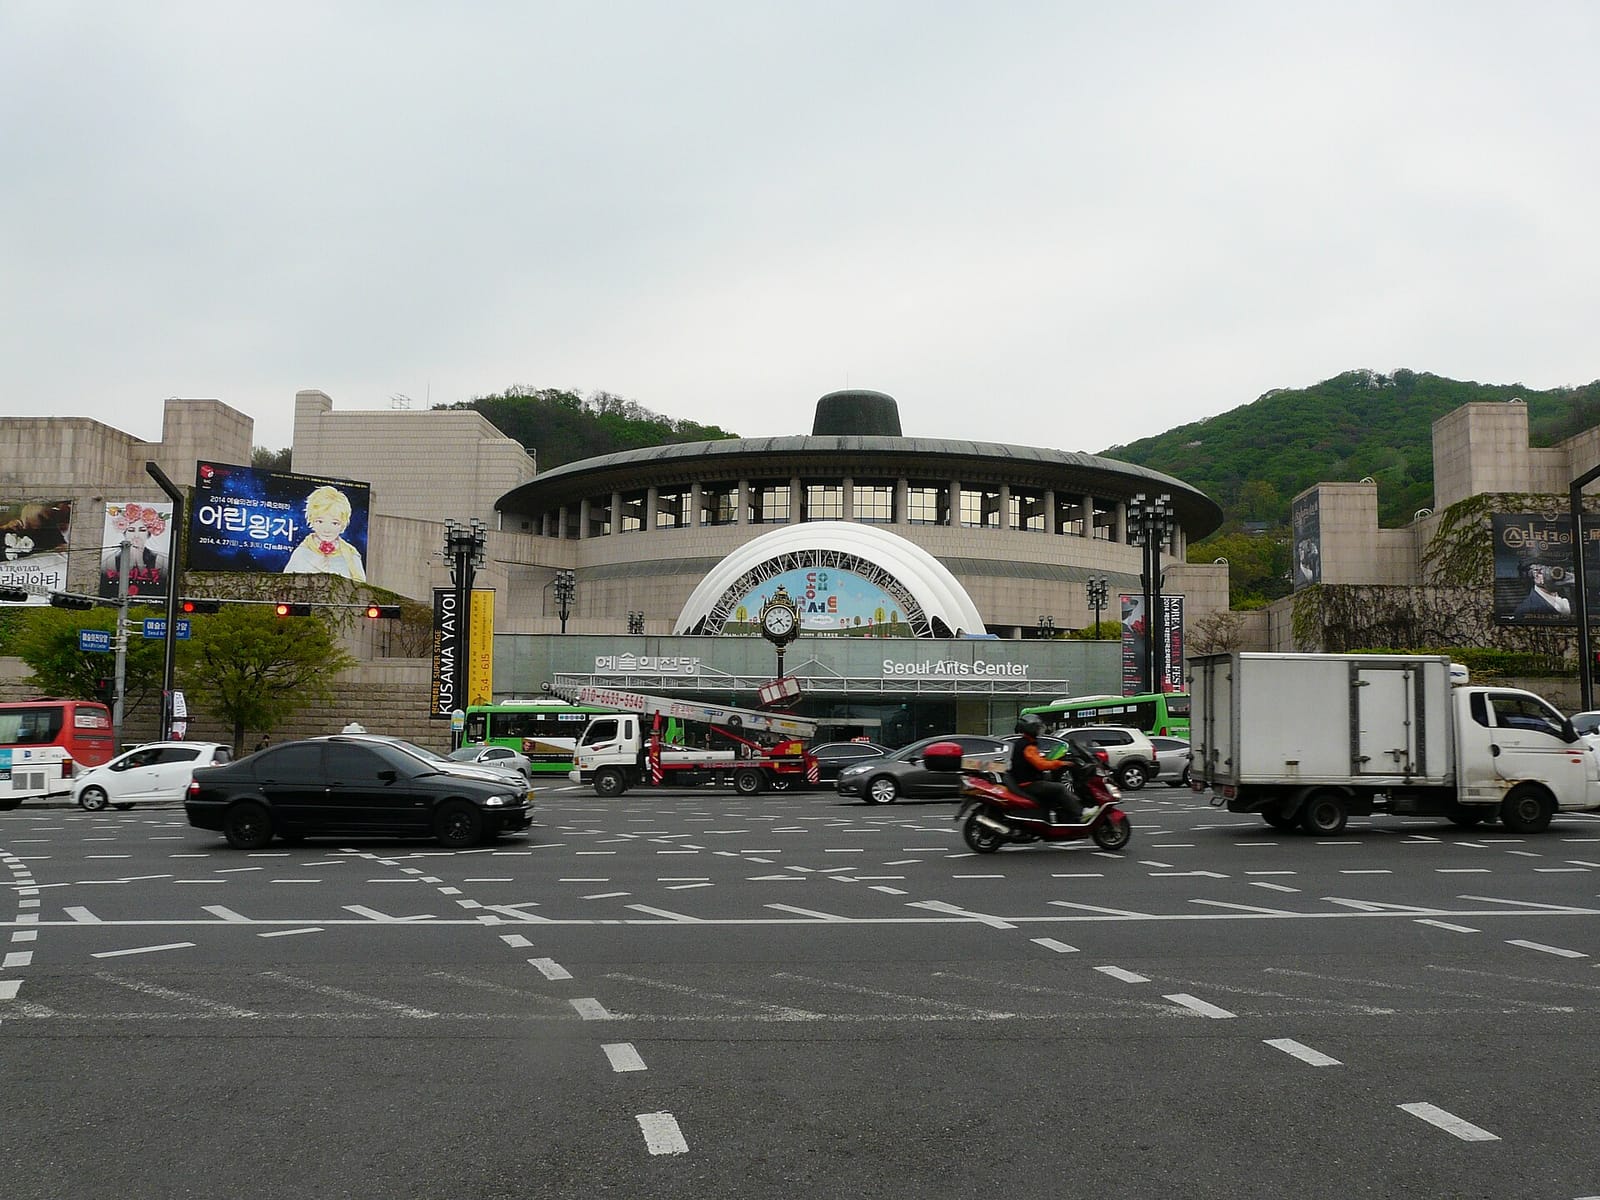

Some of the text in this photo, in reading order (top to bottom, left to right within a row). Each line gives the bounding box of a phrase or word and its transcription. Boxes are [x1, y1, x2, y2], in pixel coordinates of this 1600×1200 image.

[210, 495, 226, 503] 2014
[226, 496, 259, 507] 예술의전당
[199, 505, 298, 542] 어린왕자
[5, 565, 41, 573] TRAVIATA
[1171, 598, 1180, 630] KOREA
[438, 594, 457, 715] KUSAMA YAYOI
[1171, 631, 1180, 664] OPERA
[433, 655, 441, 679] SUPER
[595, 652, 701, 674] 예술의전당
[882, 659, 1029, 675] Seoul Arts Center
